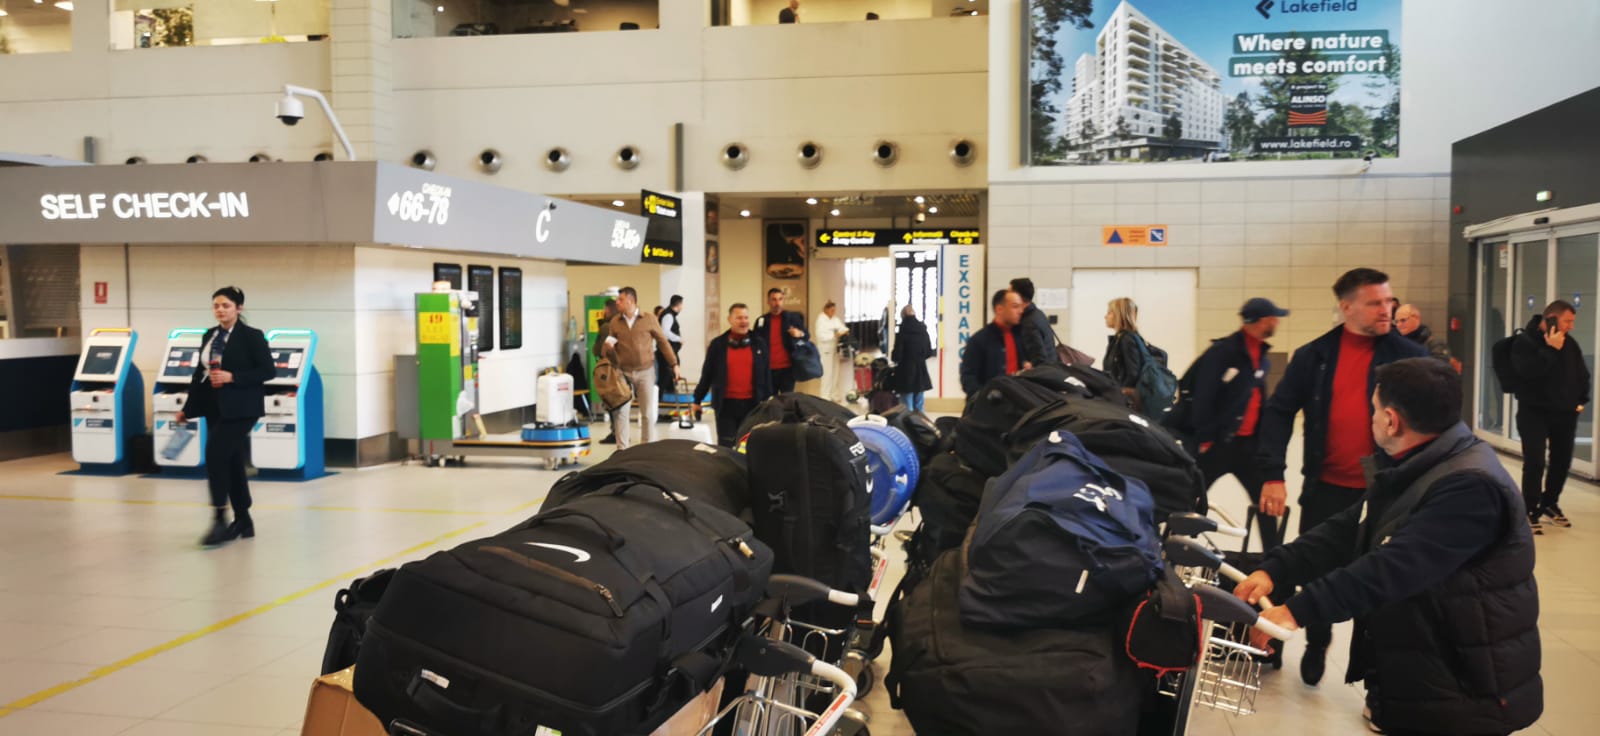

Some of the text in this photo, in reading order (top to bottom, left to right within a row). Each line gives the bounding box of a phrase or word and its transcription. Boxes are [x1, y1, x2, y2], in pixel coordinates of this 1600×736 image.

[1281, 0, 1357, 13] Lakefield
[1238, 33, 1383, 52] Where nature
[1233, 55, 1387, 75] meets comfort
[1290, 95, 1326, 104] ALINSO
[1260, 138, 1352, 149] www.lakefield.ro
[40, 192, 249, 220] SELF CHECK-IN
[399, 190, 450, 225] 66-78
[535, 209, 551, 243] C
[958, 254, 971, 373] EXCHAN
